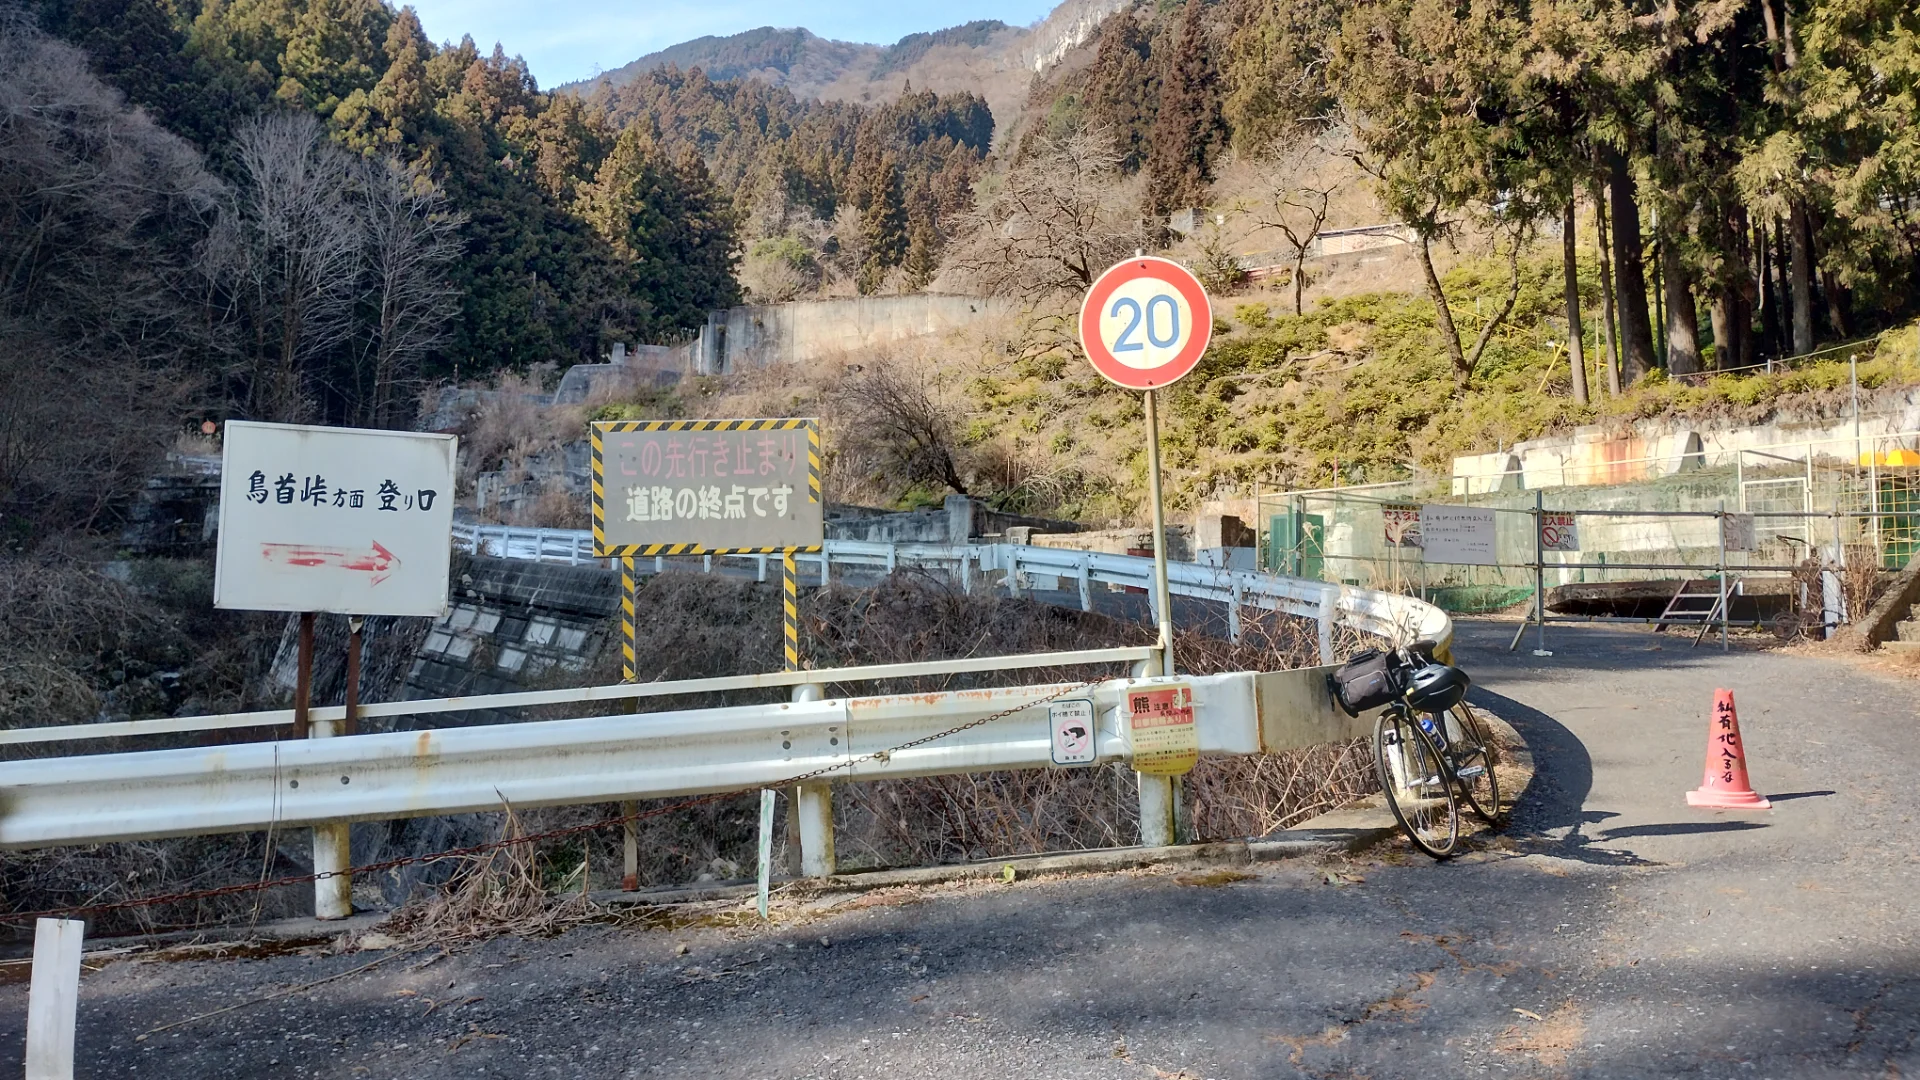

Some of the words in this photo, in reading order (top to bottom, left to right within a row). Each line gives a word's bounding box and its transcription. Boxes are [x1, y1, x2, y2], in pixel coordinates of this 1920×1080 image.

[1110, 294, 1180, 353] 20
[620, 433, 797, 479] この先行き止まり
[376, 479, 438, 512] 登り口
[626, 483, 793, 522] 道路の終点です
[1133, 696, 1150, 714] 熊
